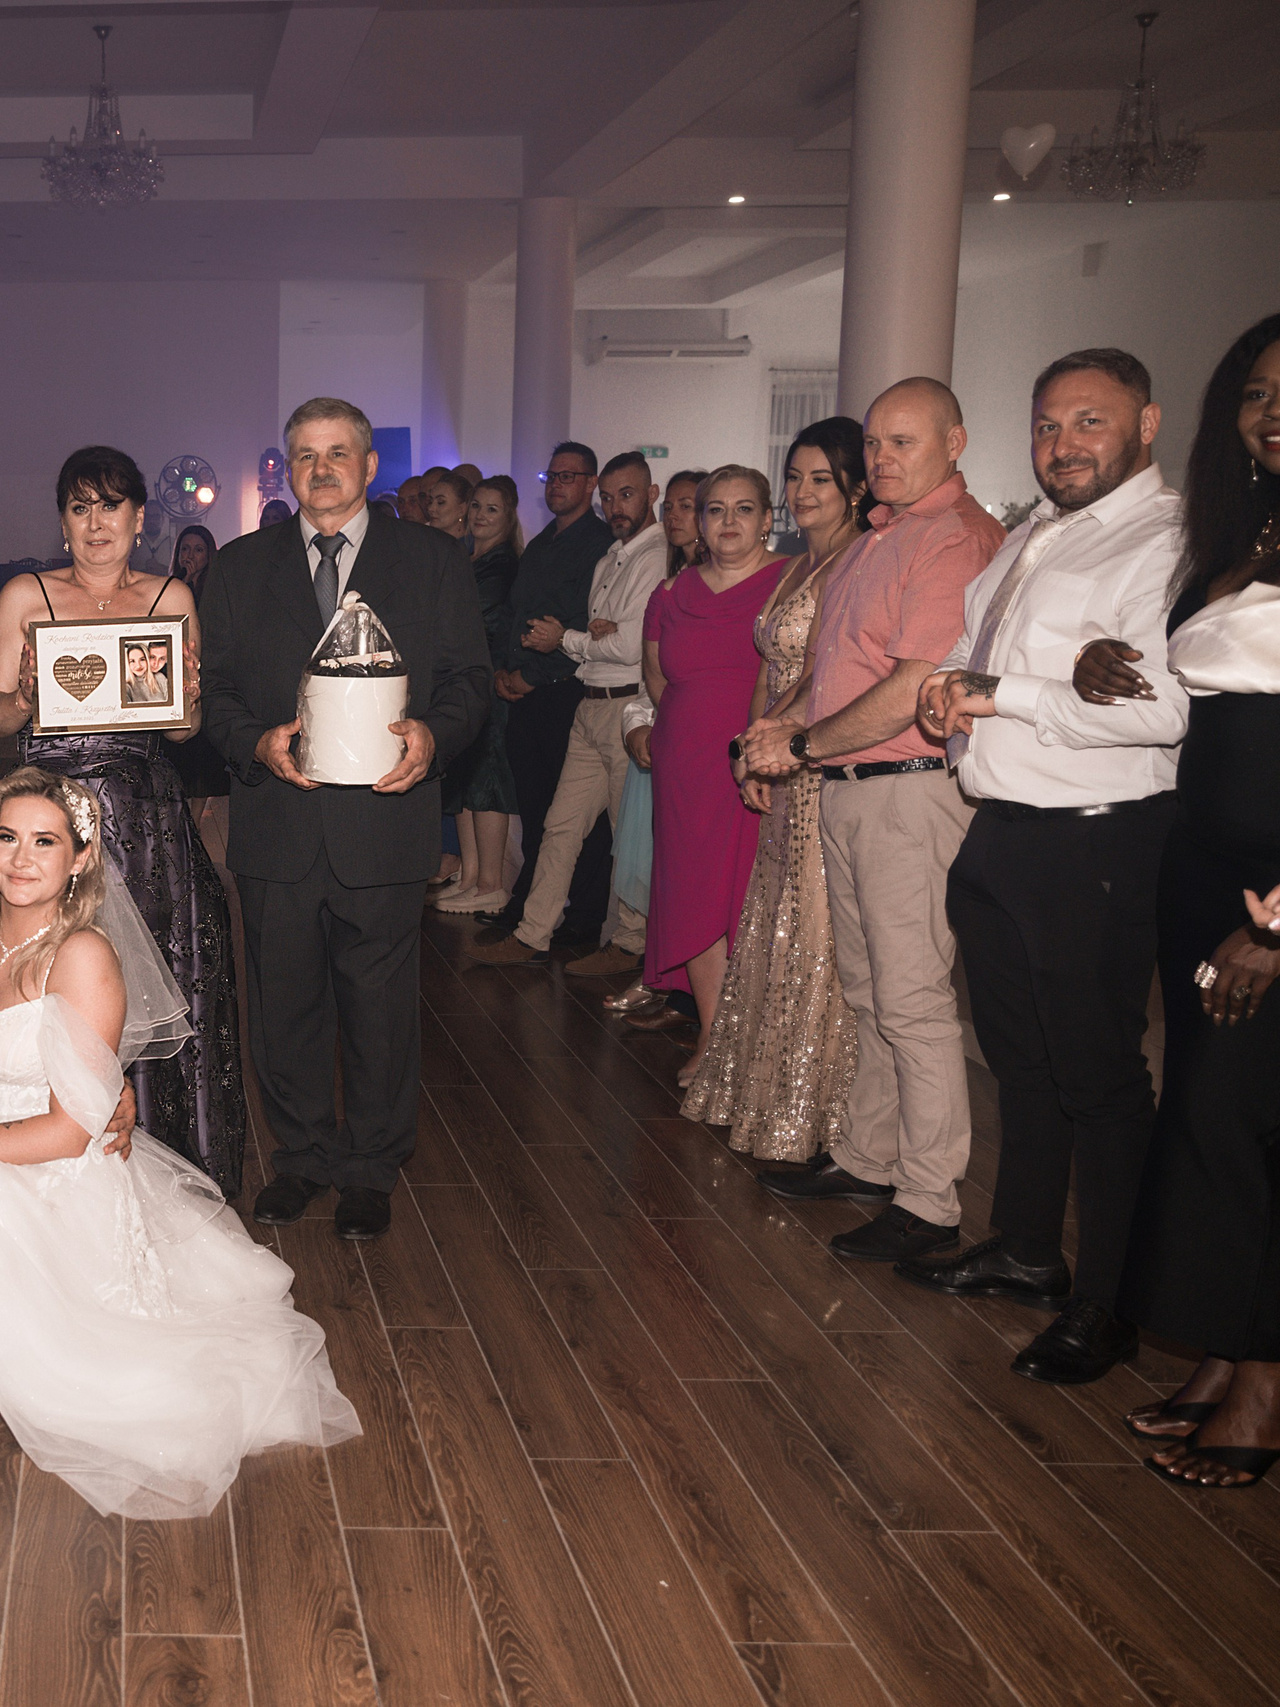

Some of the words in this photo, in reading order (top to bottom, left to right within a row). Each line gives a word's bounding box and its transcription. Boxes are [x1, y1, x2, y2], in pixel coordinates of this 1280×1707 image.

[45, 635, 80, 645] Kochani
[81, 632, 115, 643] Rodzice
[68, 667, 92, 679] miłość
[80, 704, 117, 716] Krzysztof
